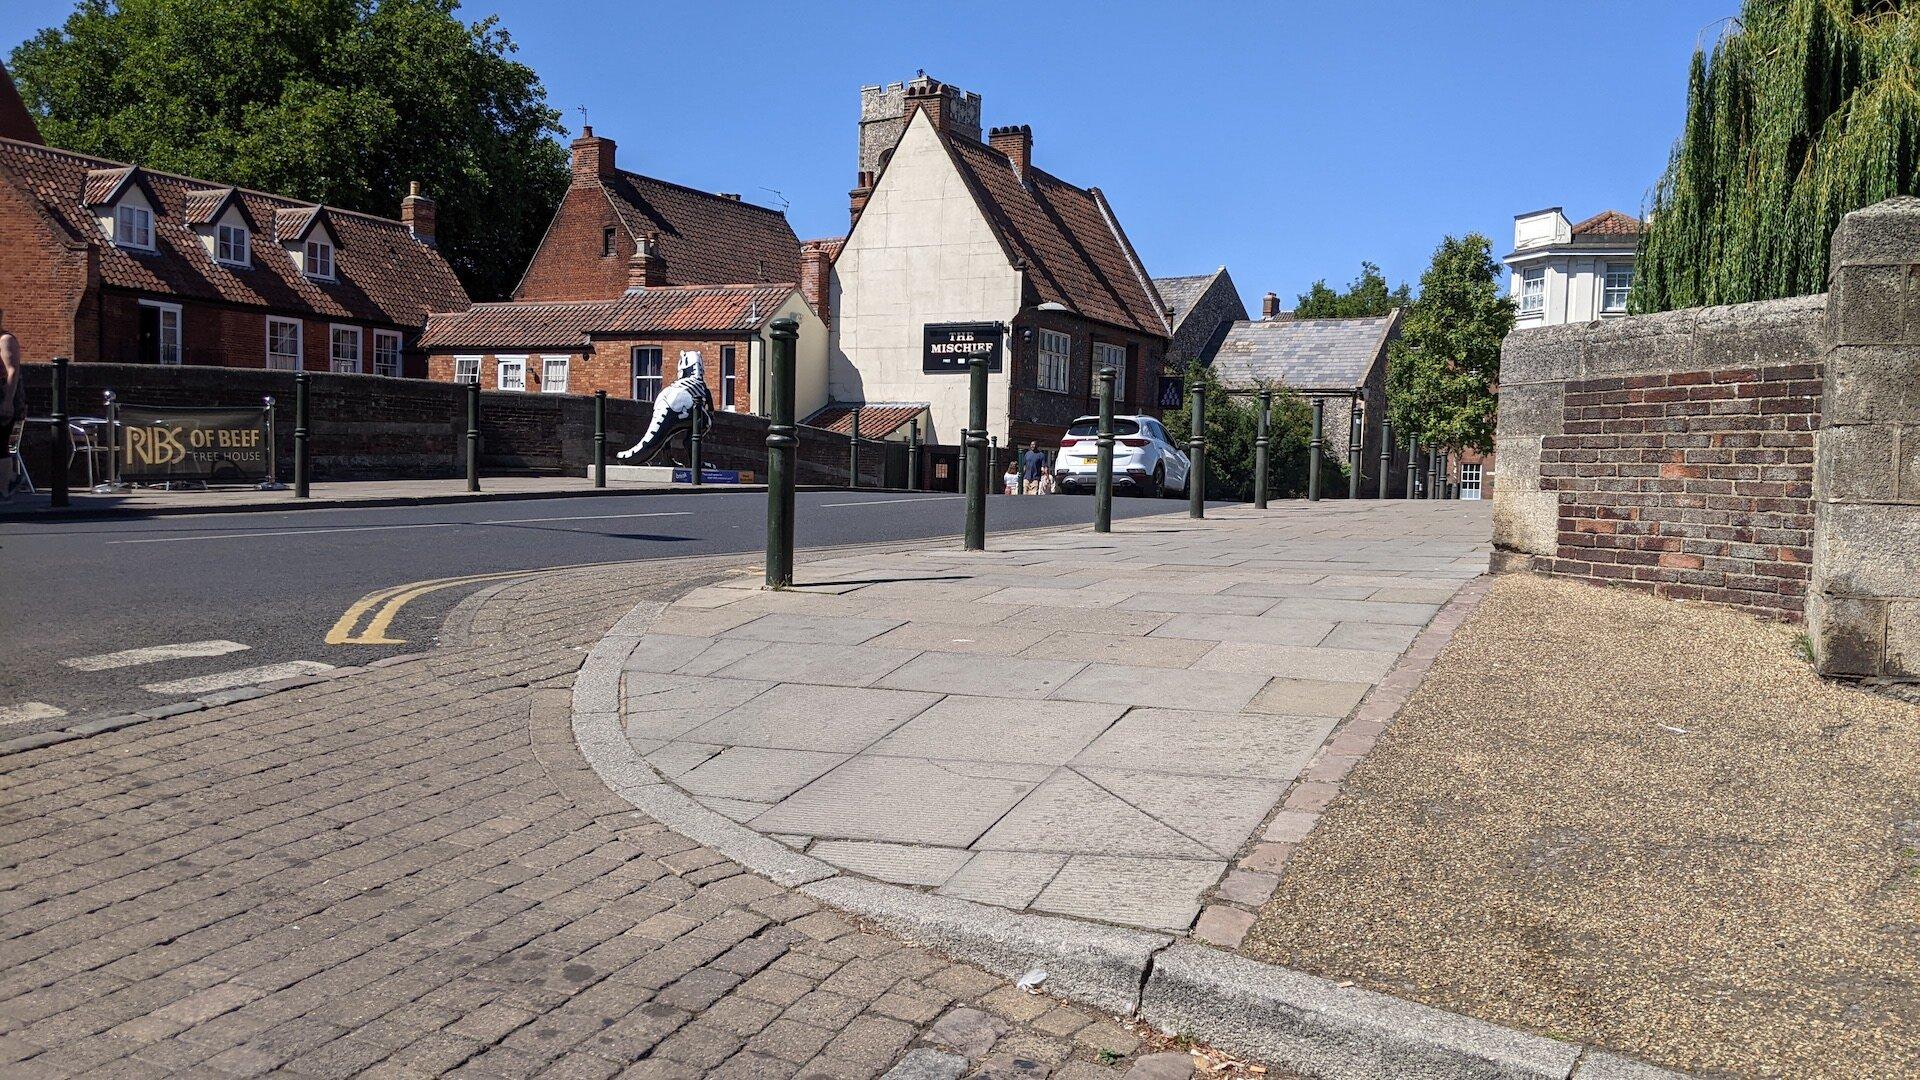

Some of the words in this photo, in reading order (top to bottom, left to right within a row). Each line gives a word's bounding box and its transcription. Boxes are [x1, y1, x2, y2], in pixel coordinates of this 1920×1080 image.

[949, 332, 974, 341] THE
[931, 343, 993, 353] MISCHIEF
[126, 426, 186, 465] RIBS
[190, 429, 214, 448] OF
[218, 429, 260, 448] BEEF
[193, 452, 219, 462] FREE
[224, 451, 261, 461] HOUSE
